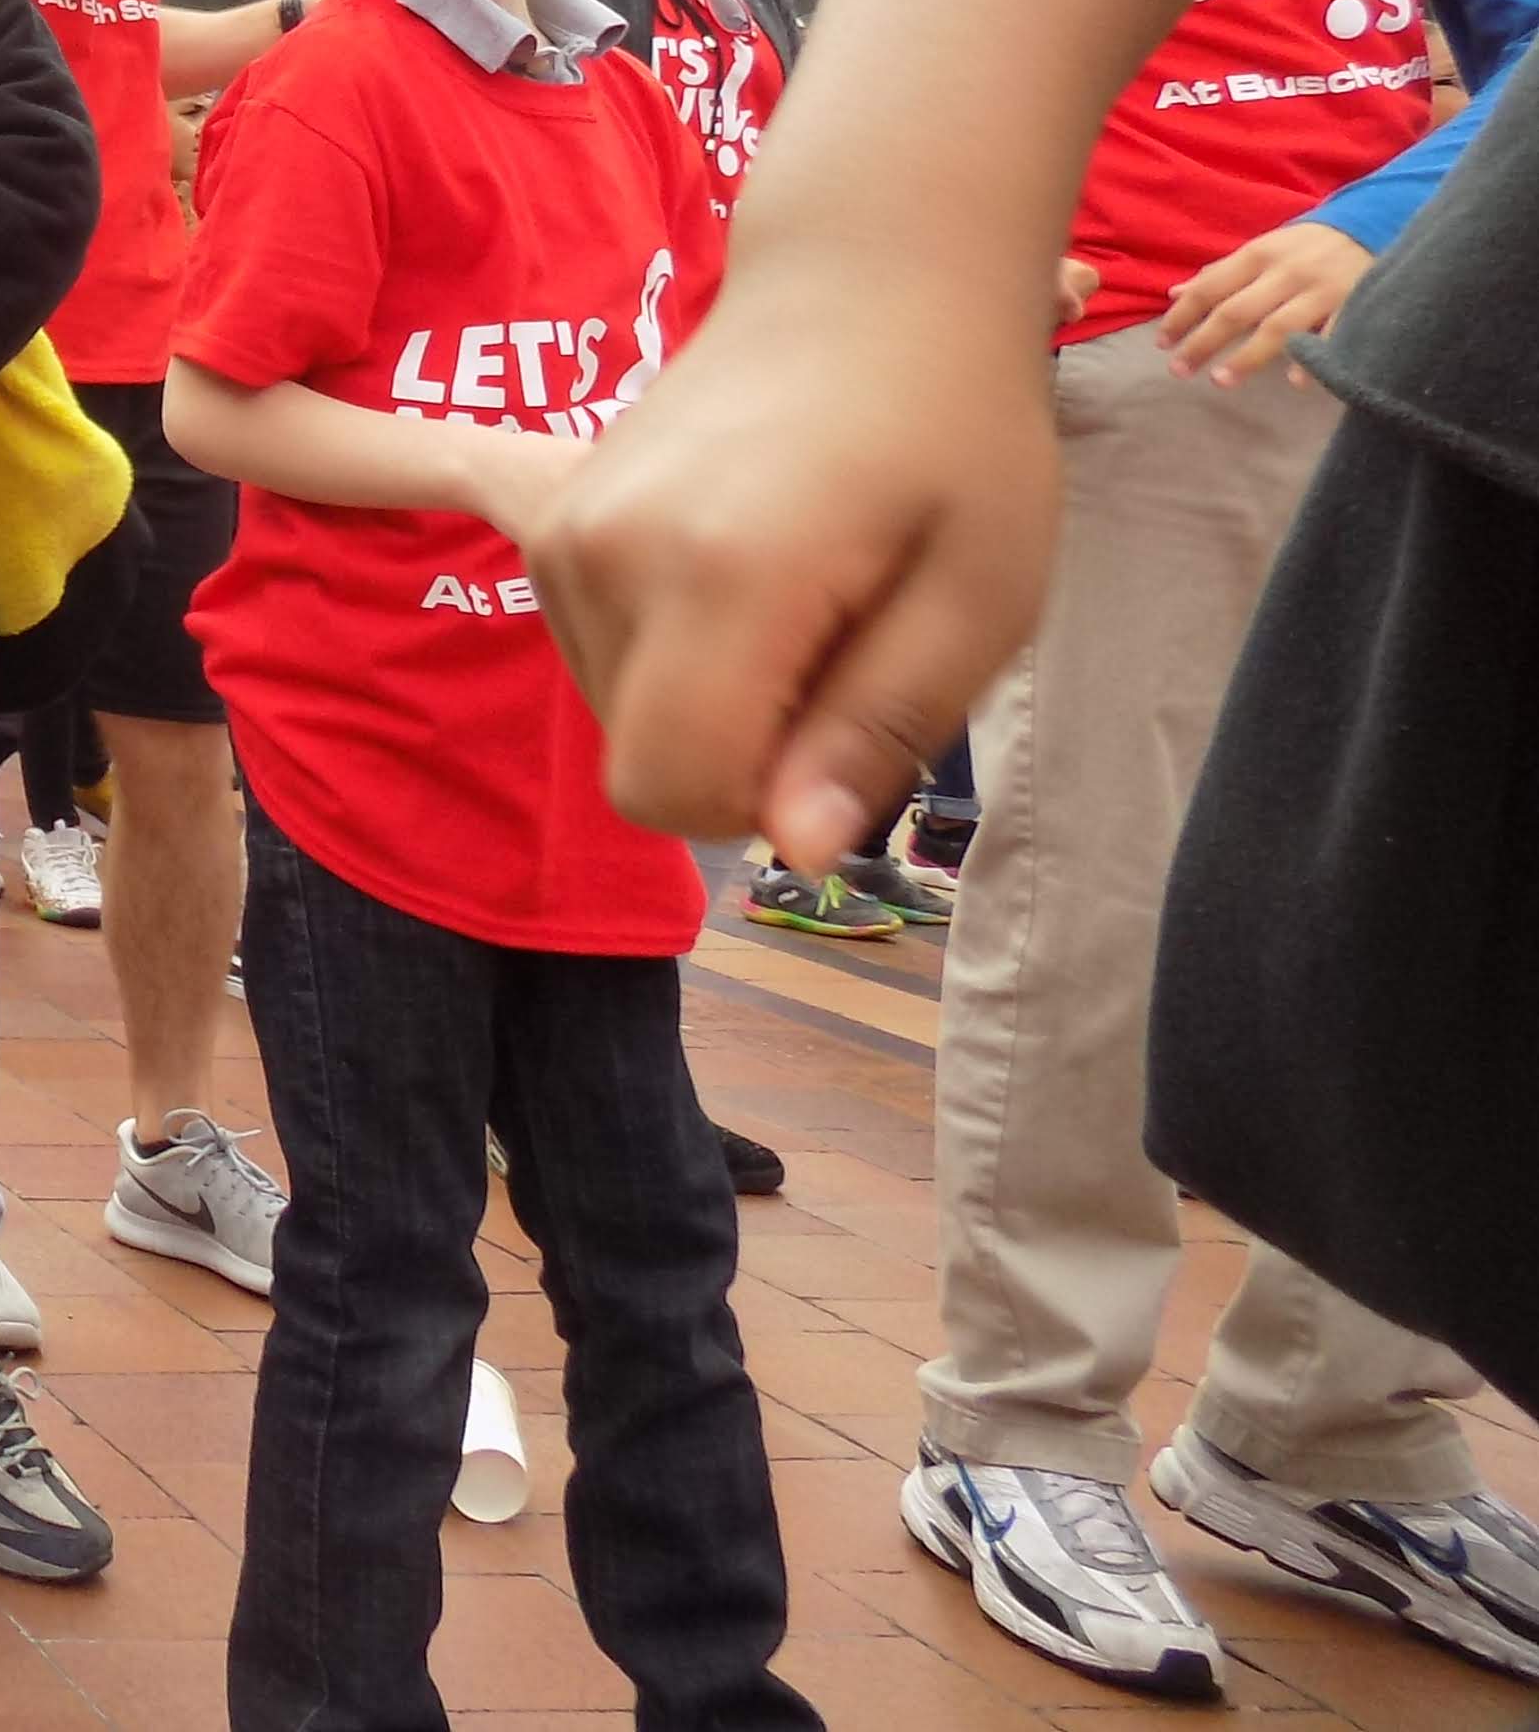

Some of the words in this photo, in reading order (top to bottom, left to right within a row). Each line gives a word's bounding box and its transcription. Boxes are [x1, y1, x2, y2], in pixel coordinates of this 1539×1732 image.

[651, 35, 710, 87] T'S
[1155, 80, 1223, 110] At
[391, 316, 608, 409] LET'S
[421, 573, 492, 617] At
